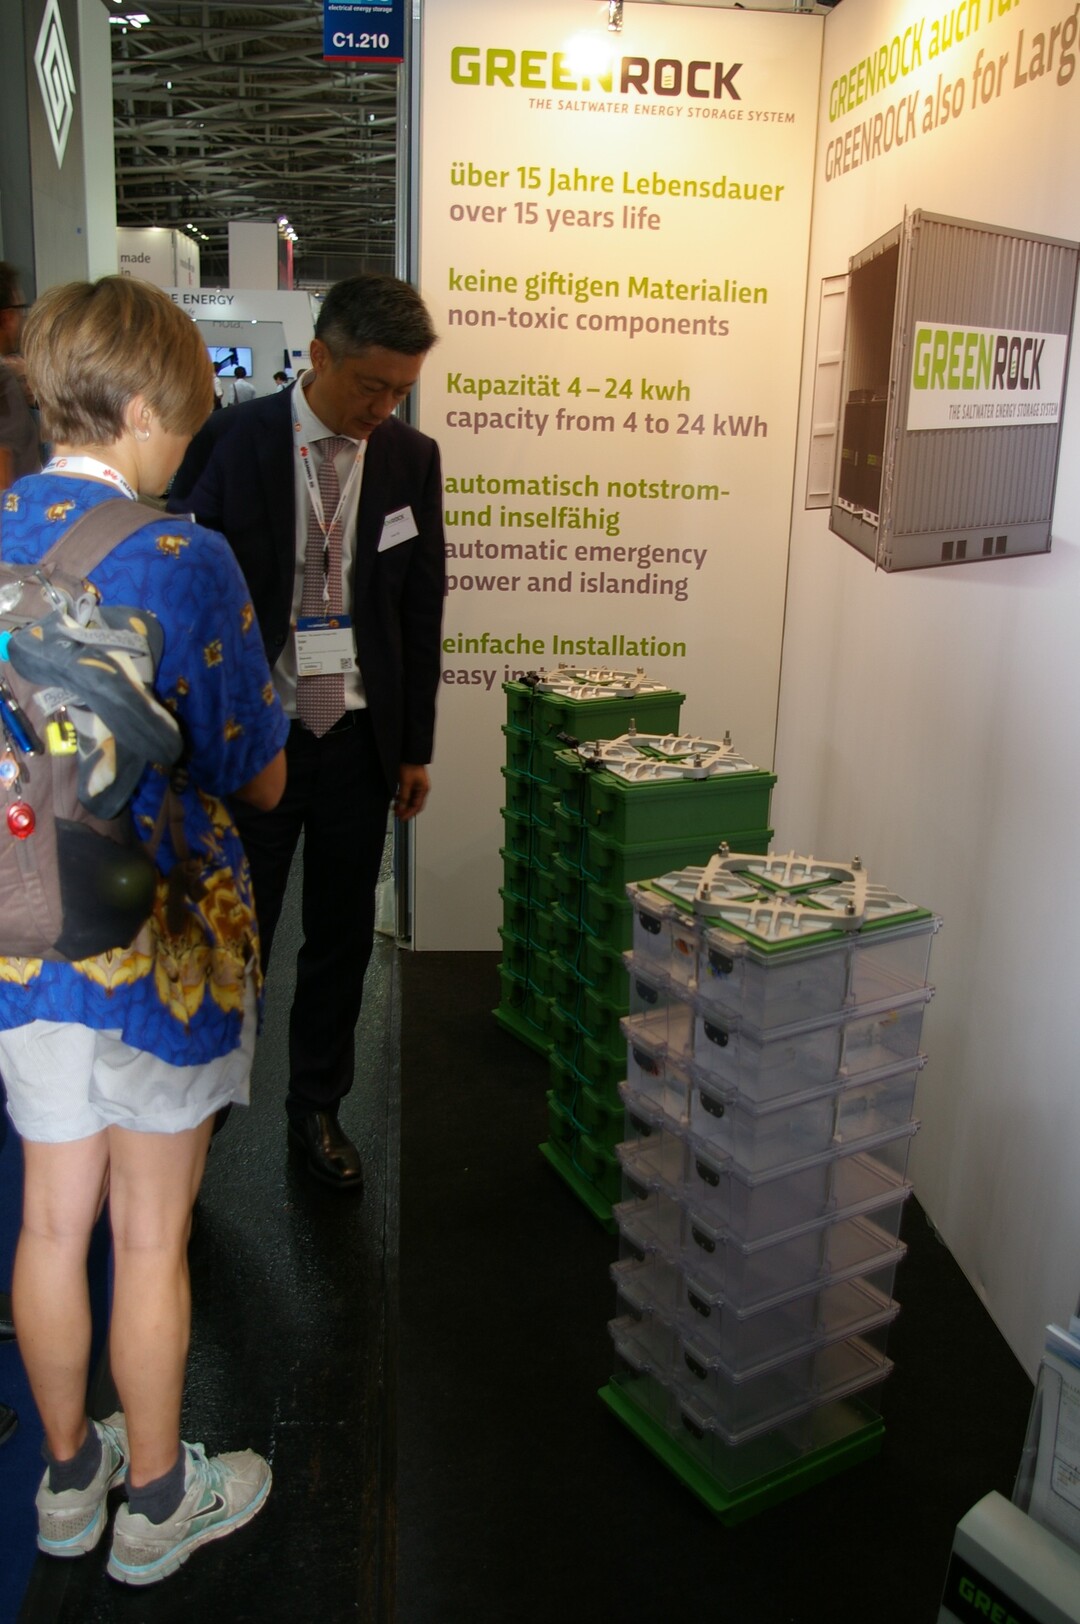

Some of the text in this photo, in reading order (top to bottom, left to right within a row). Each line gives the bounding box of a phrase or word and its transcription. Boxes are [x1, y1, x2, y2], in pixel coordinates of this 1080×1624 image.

[332, 32, 390, 49] C1.210
[829, 18, 925, 123] GREENROCK
[825, 2, 1080, 183] GREENROCK also for Larg
[529, 98, 796, 124] THE SALTWATER ENERGY STORAGE SYSTEM
[450, 162, 785, 202] über 15 Jahre Lebensdauer
[450, 202, 661, 232] over 15 years life
[120, 252, 151, 264] made
[183, 294, 234, 305] ENERGY
[449, 268, 769, 304] keine giftigen Materialien
[448, 306, 730, 339] non-toxic components
[913, 329, 1045, 390] GREENROCK
[446, 373, 560, 401] Kapazität
[567, 377, 582, 398] 4
[605, 378, 633, 400] 24
[640, 379, 691, 402] kwh
[446, 407, 769, 438] capacity from 4 to 24 kWh
[949, 402, 1058, 420] THE SALTWATER ENERGY STORAGE SYSTEM
[445, 474, 730, 501] automatisch notstrom-
[445, 506, 620, 537] und inselfähig
[445, 539, 707, 570] automatic emergency
[444, 571, 688, 601] power and islanding
[442, 633, 686, 657] einfache Installation
[442, 669, 497, 691] easy
